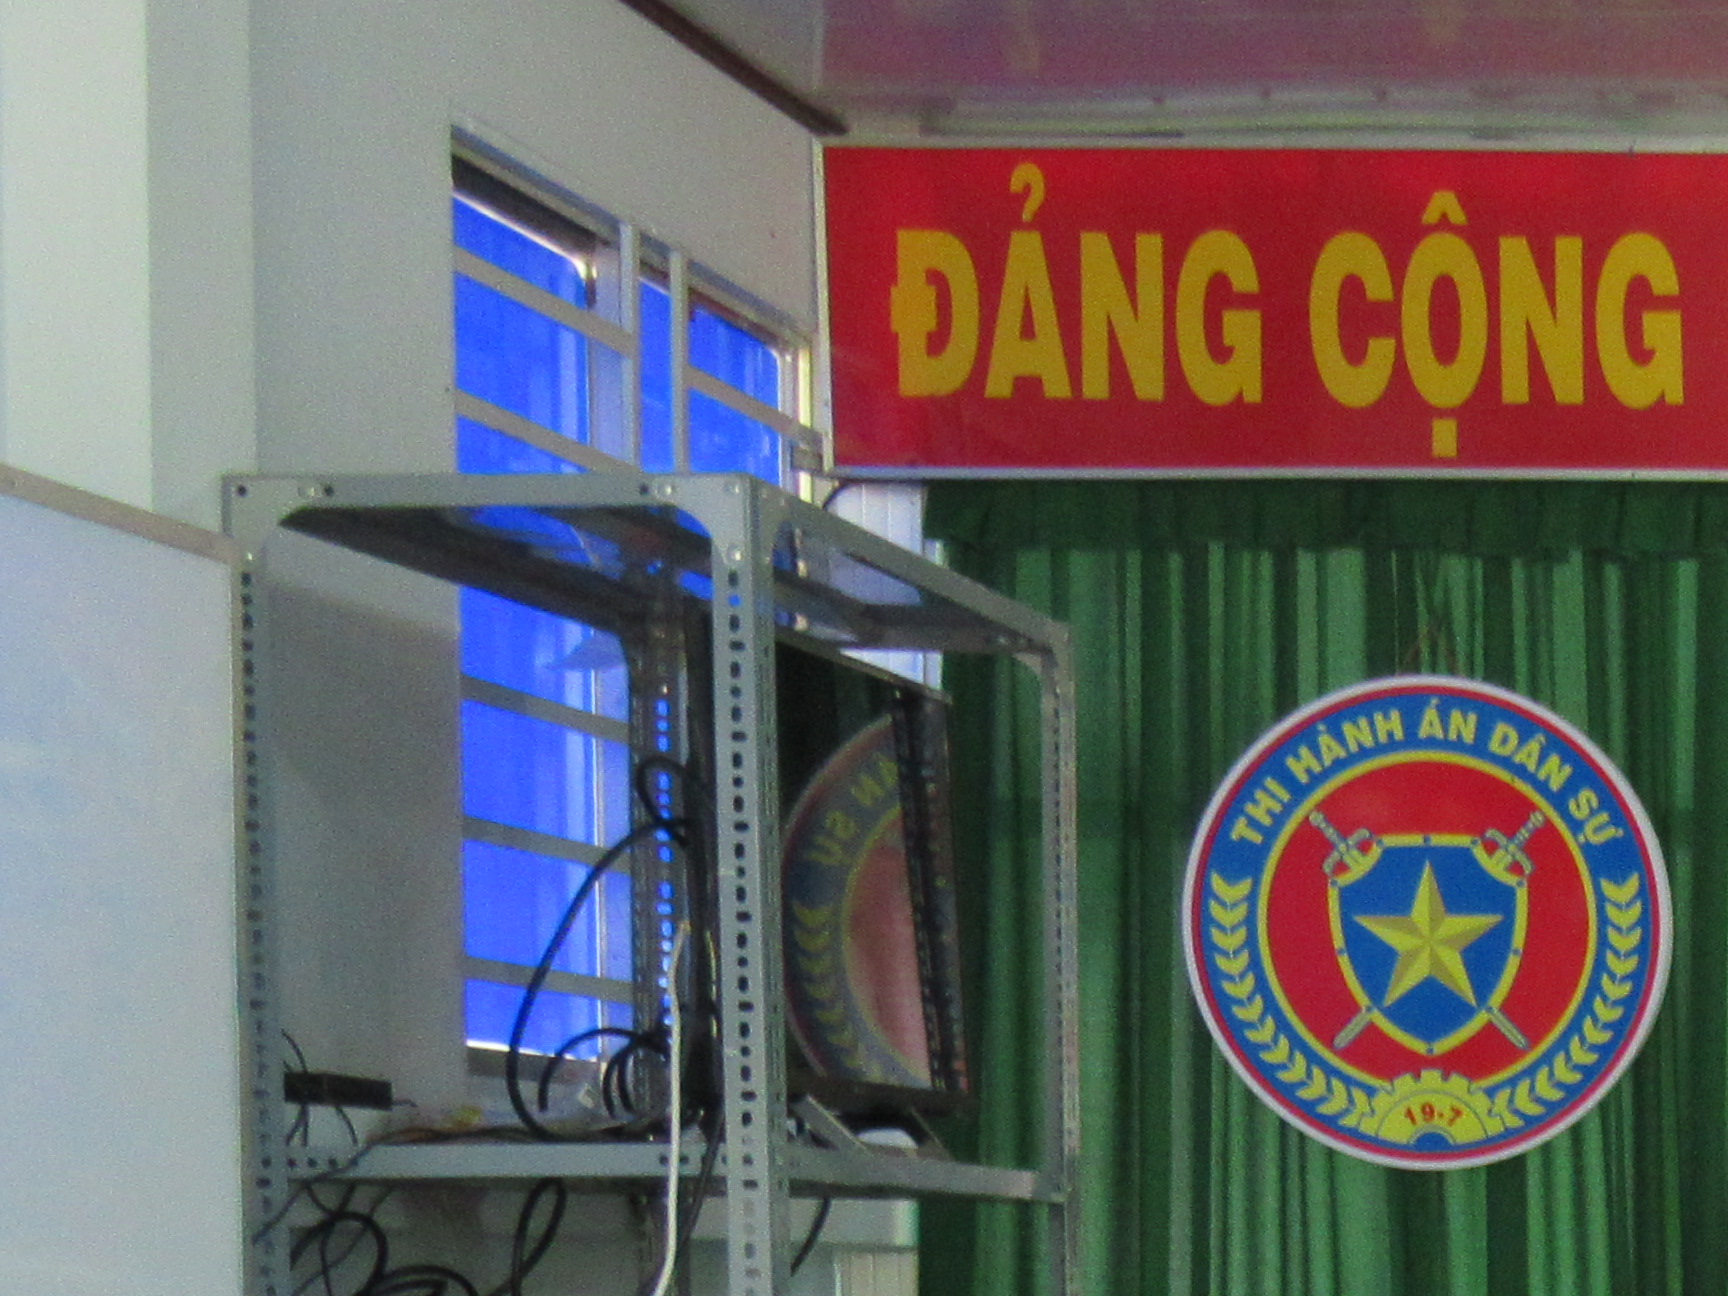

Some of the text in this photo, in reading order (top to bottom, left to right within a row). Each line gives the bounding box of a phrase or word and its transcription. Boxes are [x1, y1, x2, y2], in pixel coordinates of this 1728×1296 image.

[890, 166, 1262, 405] ĐẢNG
[1309, 191, 1684, 457] CỘNG
[1230, 776, 1292, 844] THI
[1418, 698, 1479, 745] ÁN
[1488, 721, 1574, 792] DÂN
[1568, 788, 1625, 846] SỰ
